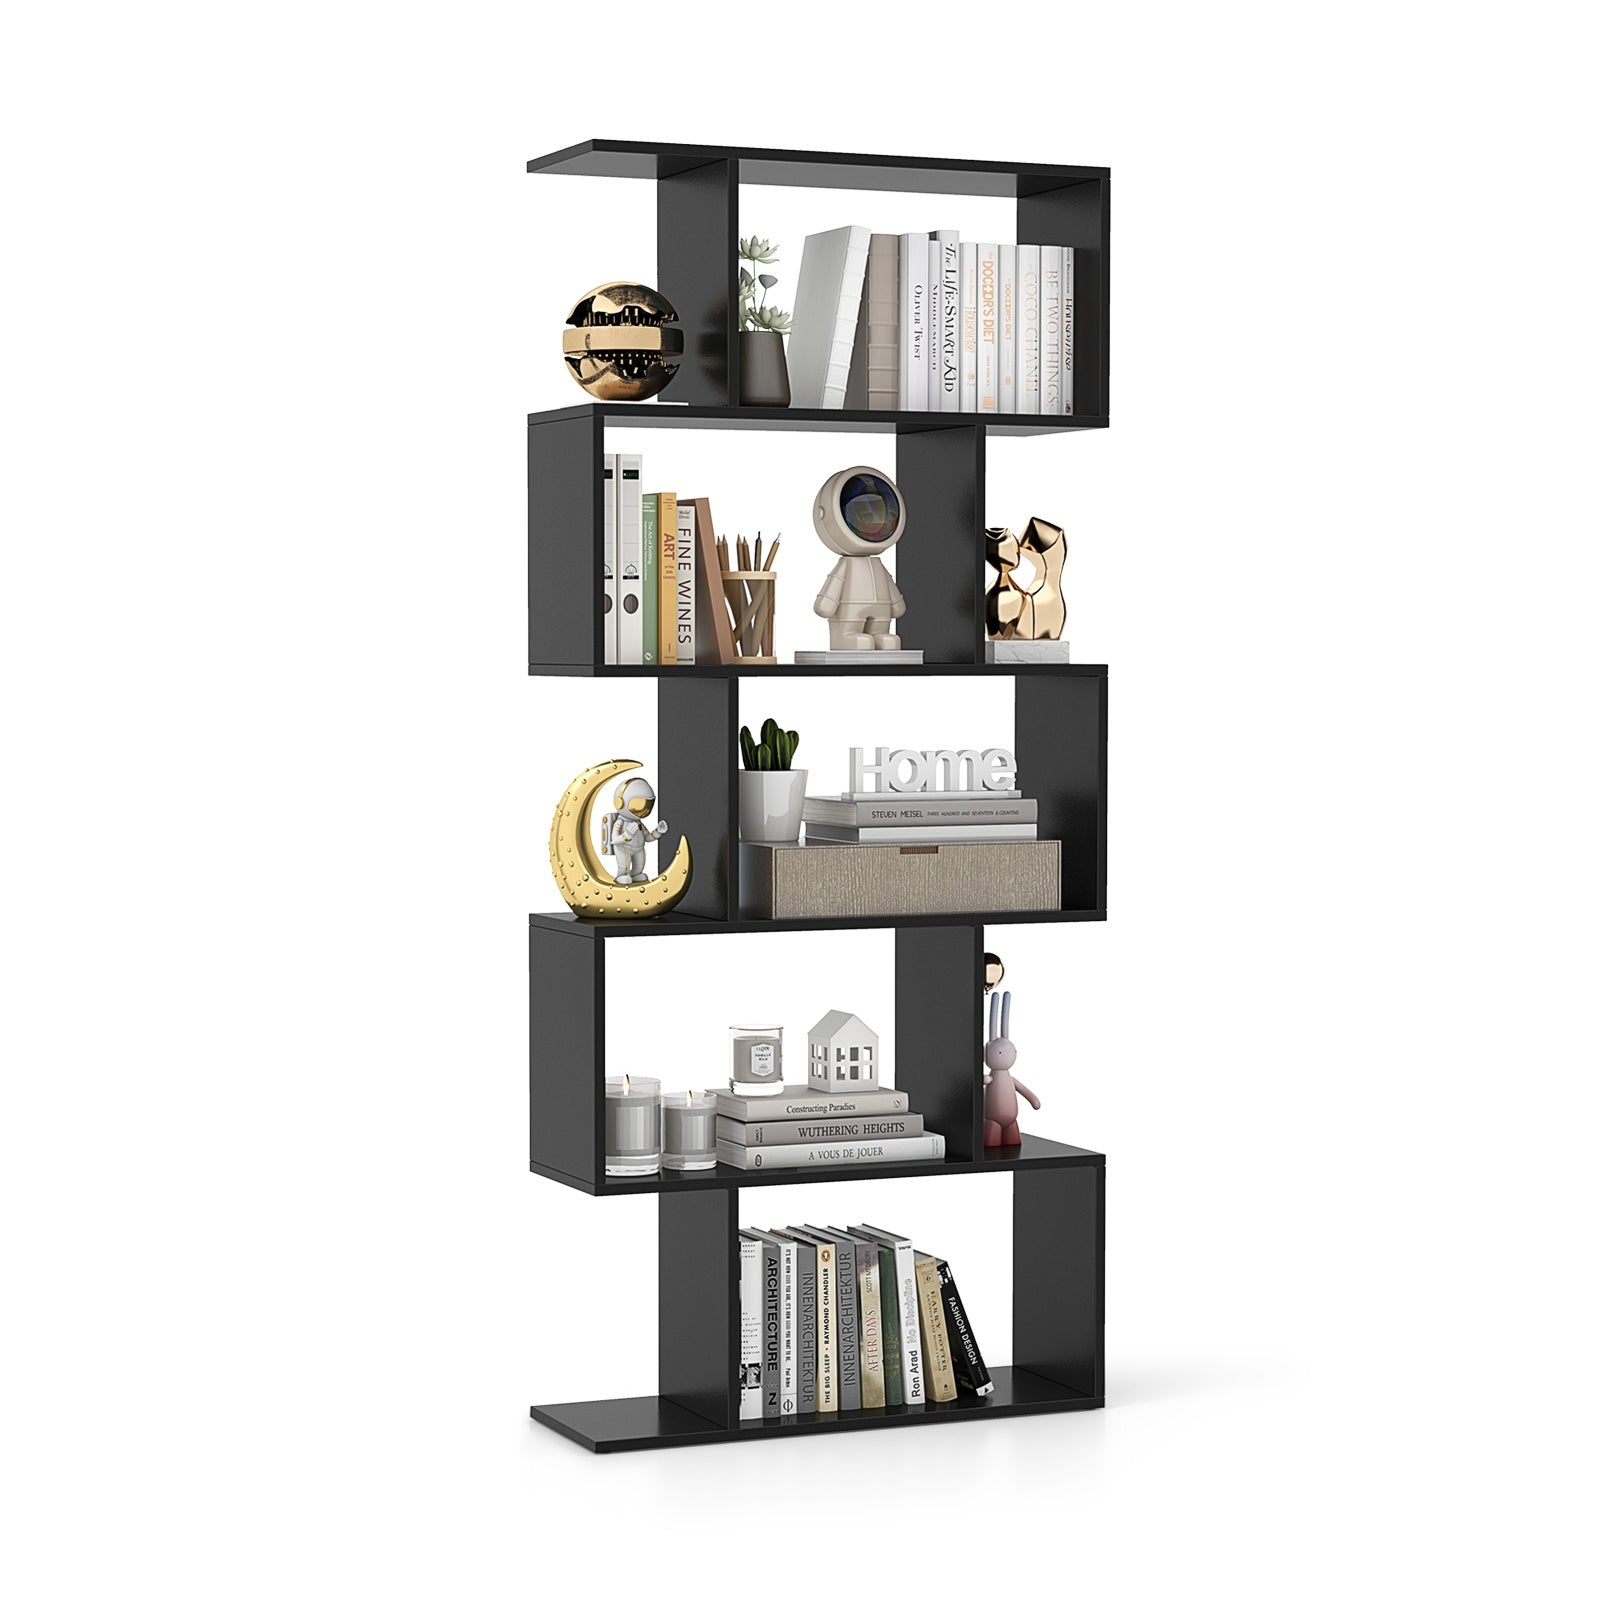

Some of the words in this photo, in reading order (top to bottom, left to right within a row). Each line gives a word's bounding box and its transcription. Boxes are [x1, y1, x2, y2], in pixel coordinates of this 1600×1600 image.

[1045, 269, 1058, 288] BE
[983, 318, 995, 345] DIET
[1046, 295, 1059, 335] TWO
[1025, 326, 1038, 397] CHANEL
[664, 533, 675, 560] ART
[678, 528, 691, 571] FINE
[678, 580, 691, 644] WINES
[849, 747, 1018, 793] Home
[871, 811, 897, 819] STEVEN
[900, 810, 924, 818] MEISEL
[786, 1103, 827, 1114] Constructing
[828, 1102, 856, 1111] Paradies
[798, 1124, 859, 1138] WUTHERING
[863, 1122, 905, 1134] HEIGHTS
[808, 1151, 815, 1160] A
[818, 1149, 840, 1159] VOUS
[843, 1148, 854, 1158] DE
[856, 1147, 884, 1158] JOUER
[822, 1268, 830, 1306] CHANDLER
[767, 1257, 778, 1371] ARCHITECTURE
[839, 1252, 856, 1386] INNENARCHITEKTUR
[866, 1309, 877, 1337] DAYS
[931, 1290, 941, 1330] HARRY
[938, 1333, 948, 1372] POTTER
[948, 1296, 966, 1334] FASHION
[961, 1332, 978, 1365] DESIGN
[802, 1272, 815, 1403] INNENARCHITEKTUR
[867, 1338, 879, 1372] AFTER
[909, 1350, 919, 1374] Arad
[911, 1376, 921, 1398] Ron
